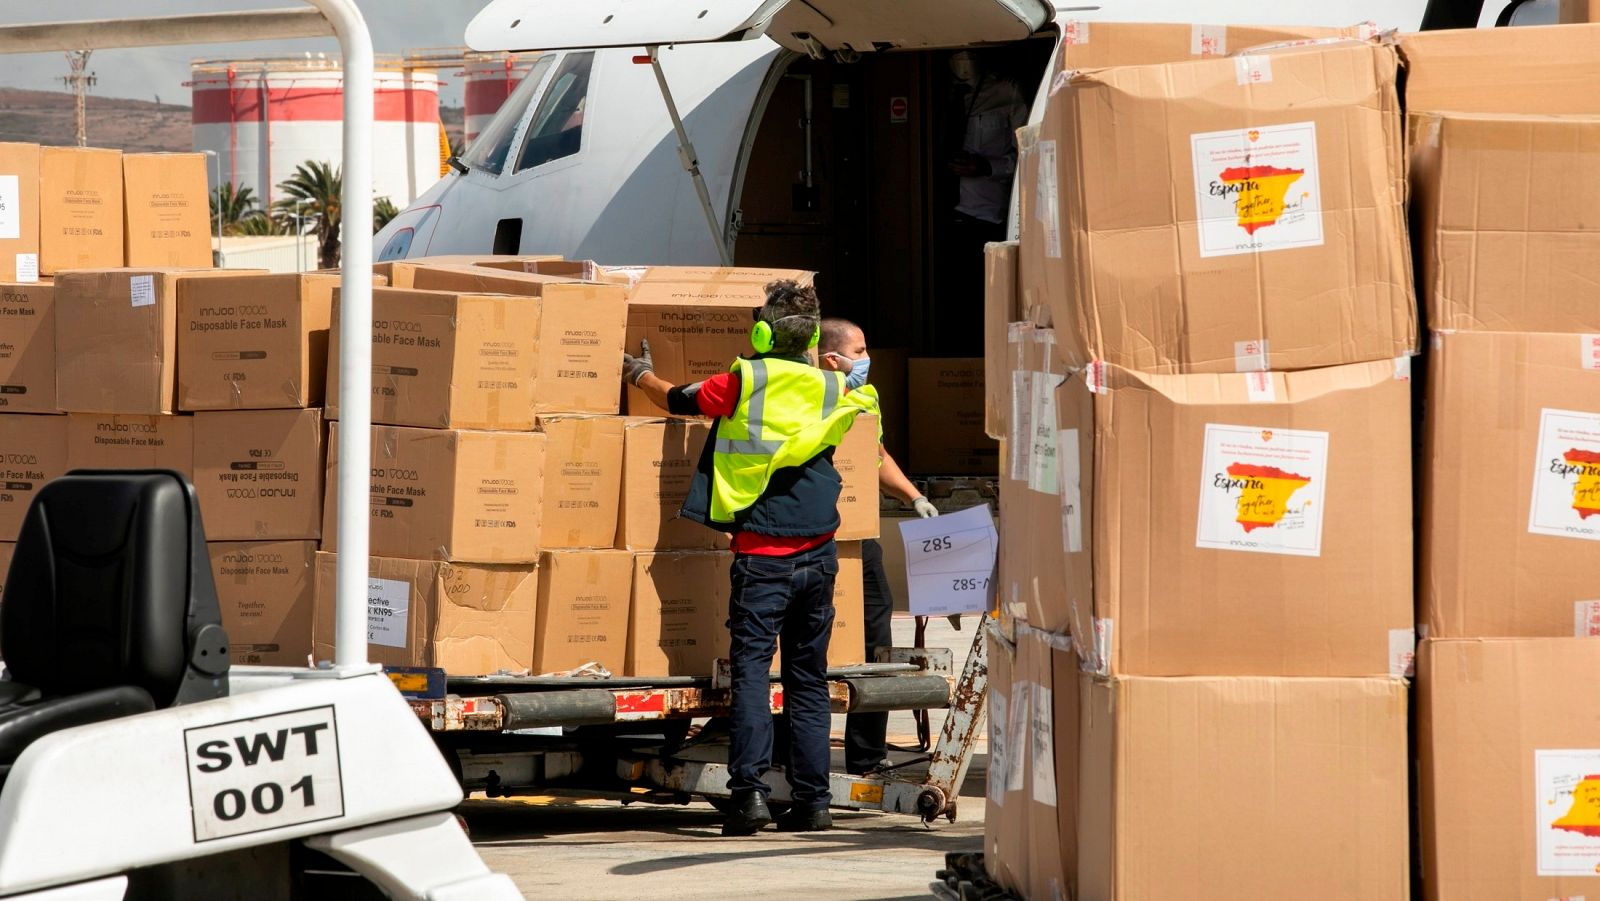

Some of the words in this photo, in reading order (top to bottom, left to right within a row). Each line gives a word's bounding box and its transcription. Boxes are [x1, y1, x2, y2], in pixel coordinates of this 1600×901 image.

[1209, 178, 1260, 200] España
[3, 308, 17, 316] Face
[19, 307, 35, 316] Mask
[190, 320, 238, 332] Disposable
[240, 320, 262, 330] Face
[264, 318, 288, 329] Mask
[658, 325, 705, 336] Disposable
[706, 326, 725, 335] Face
[727, 326, 749, 336] Mask
[393, 334, 415, 346] Face
[417, 335, 441, 349] Mask
[94, 436, 131, 446] Disposable
[132, 437, 147, 446] Face
[149, 438, 165, 447] Mask
[6, 470, 25, 480] Face
[26, 471, 45, 481] Mask
[1213, 472, 1264, 494] España
[386, 485, 405, 496] Face
[406, 487, 427, 498] Mask
[922, 535, 952, 553] 582
[220, 566, 255, 576] Disposable
[256, 567, 272, 575] Face
[272, 567, 289, 575] Mask
[368, 597, 390, 606] ective
[373, 606, 394, 617] KN95
[196, 722, 329, 774] SWT
[213, 775, 315, 822] 001
